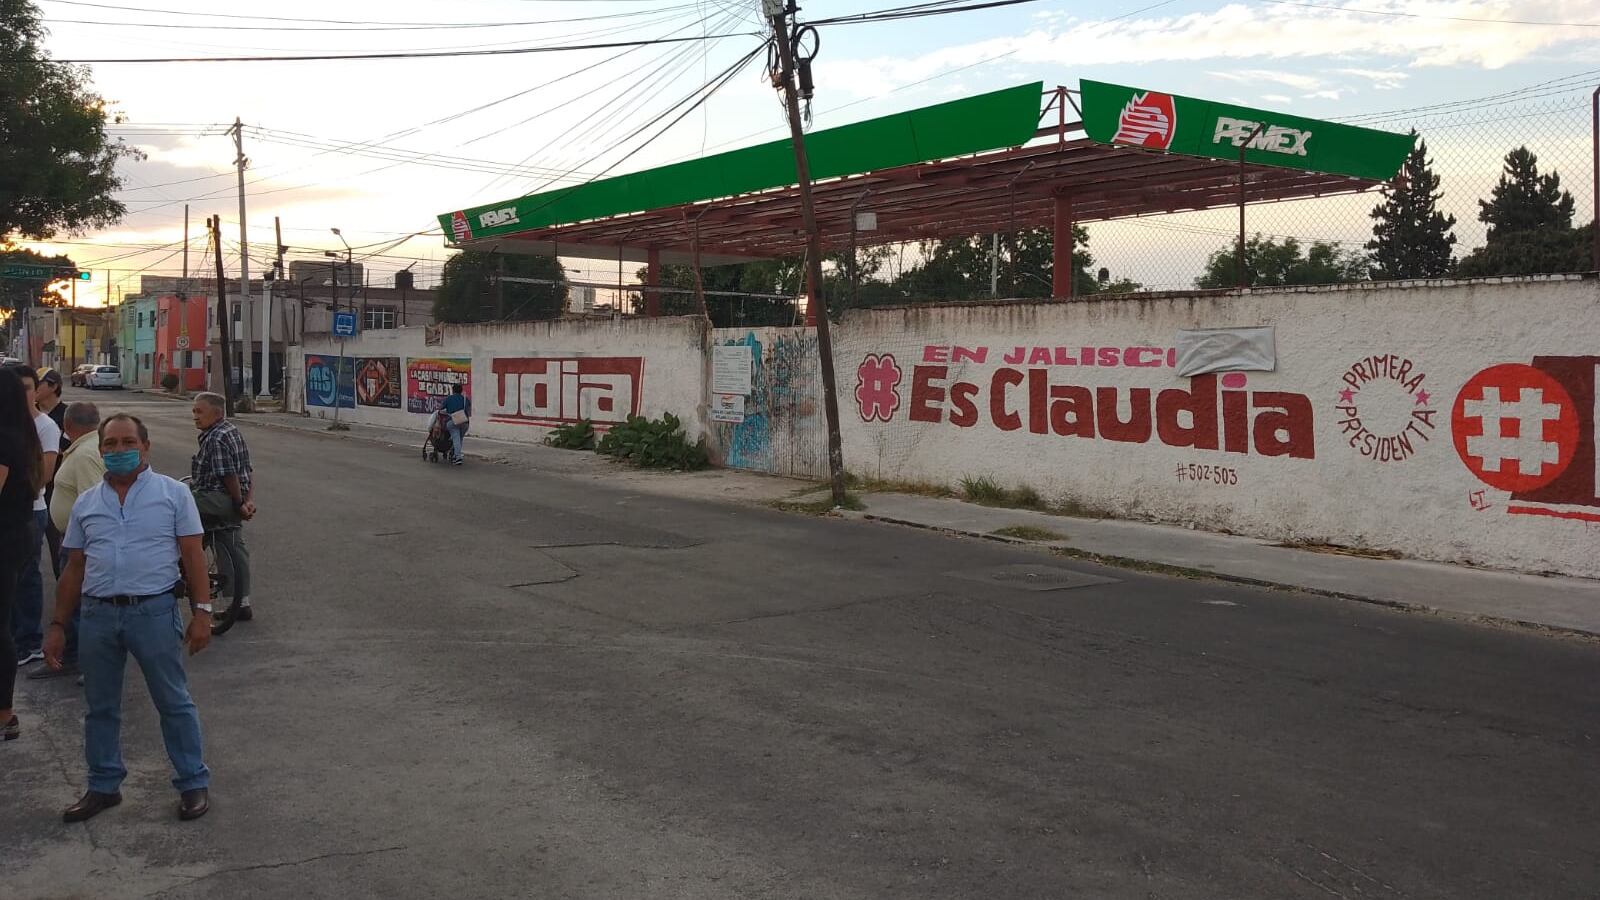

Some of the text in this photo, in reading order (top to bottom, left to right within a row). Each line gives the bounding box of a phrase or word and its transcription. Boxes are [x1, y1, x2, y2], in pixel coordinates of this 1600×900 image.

[1212, 117, 1312, 156] PEMEX
[922, 345, 1176, 367] EN JALISC
[1342, 354, 1425, 394] PRIMERA
[1335, 406, 1437, 462] PRESIDENTA
[1176, 462, 1238, 485] #502-503
